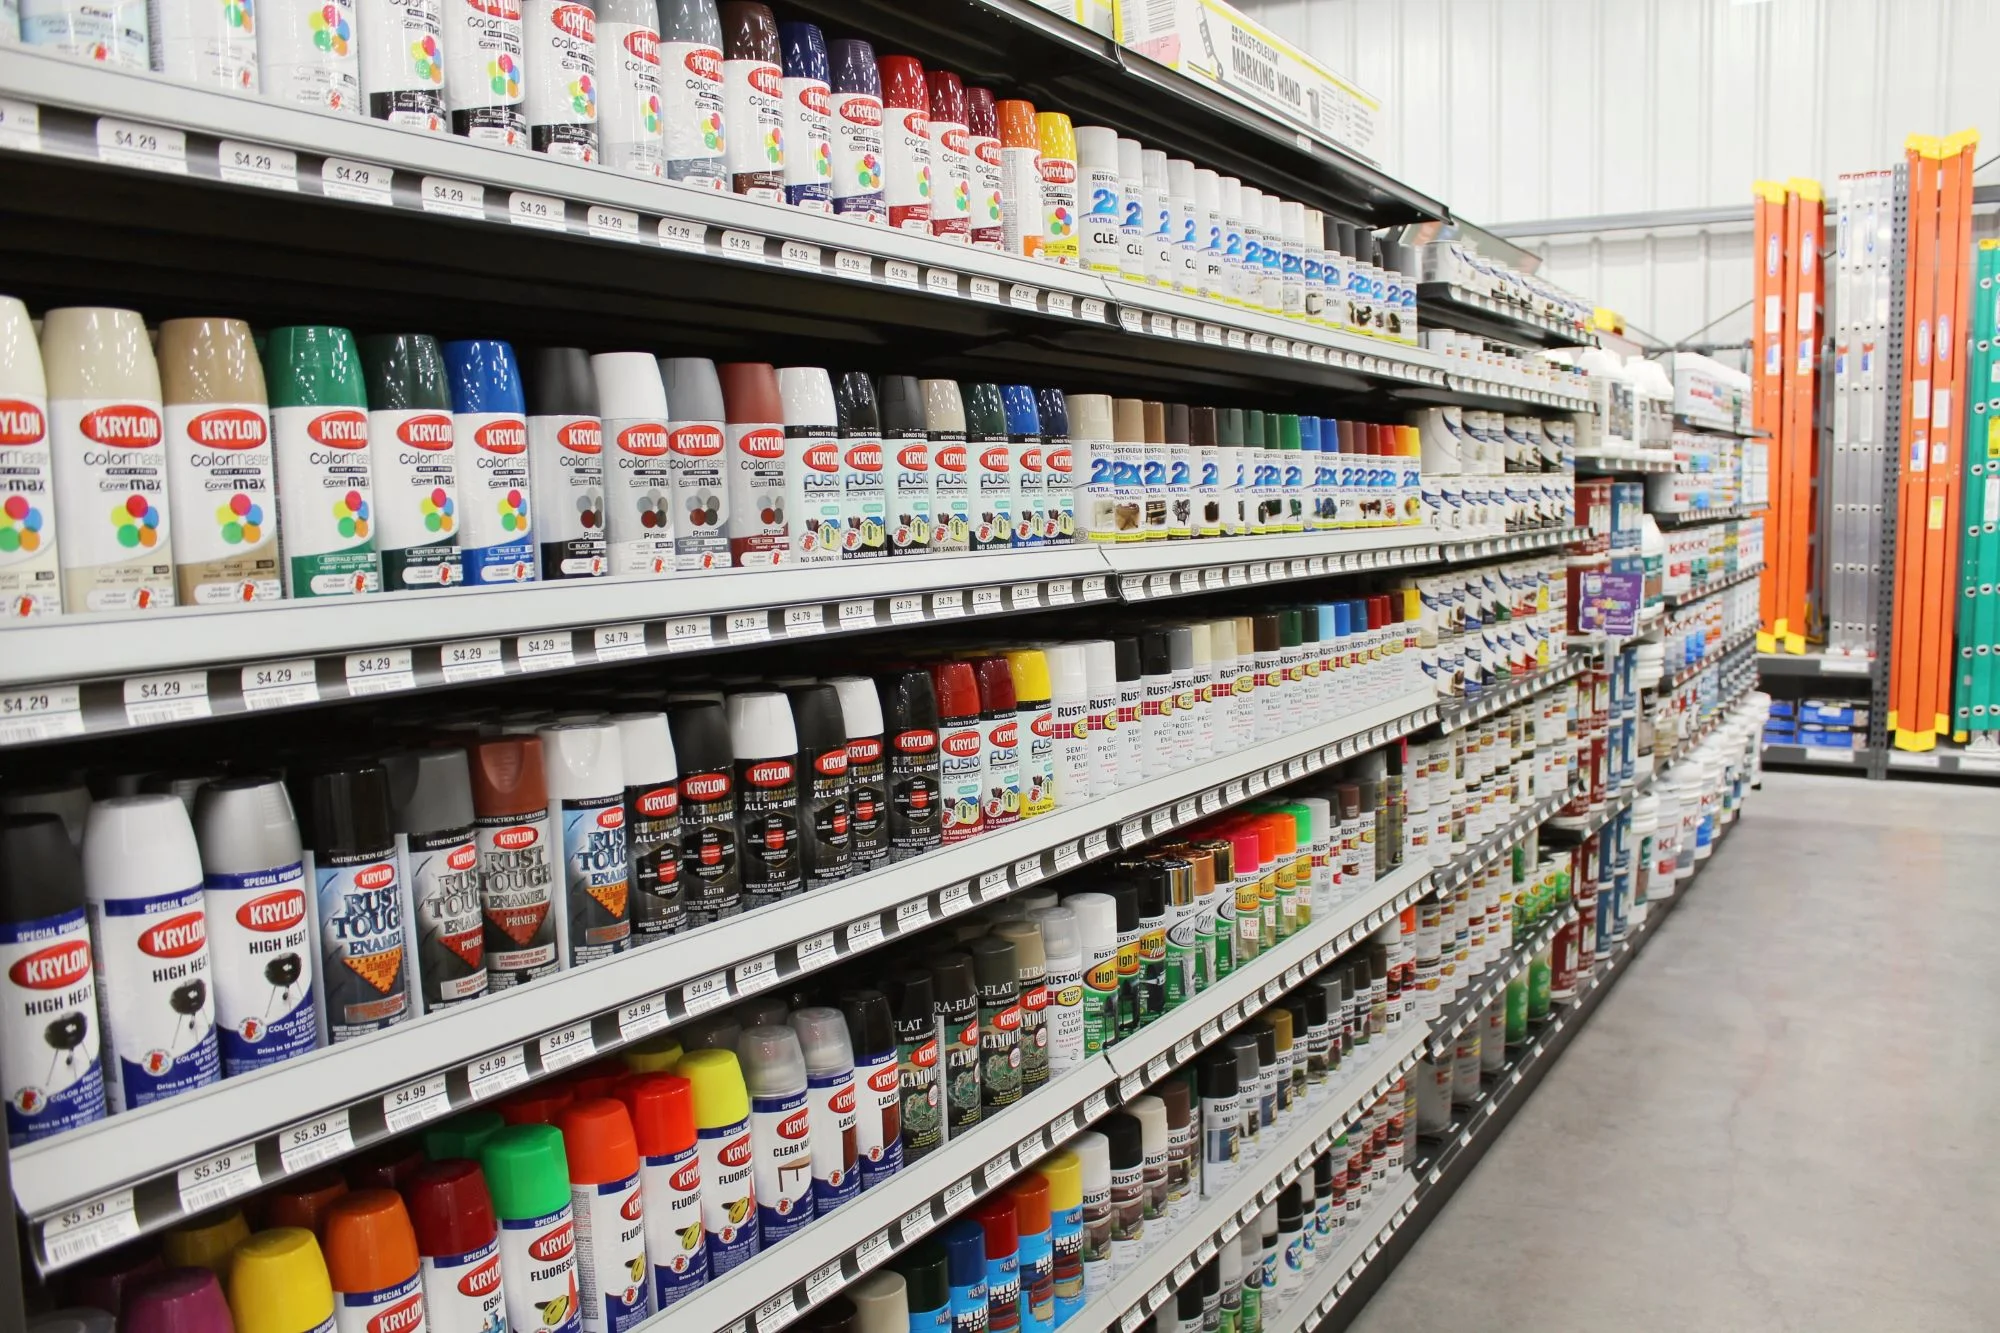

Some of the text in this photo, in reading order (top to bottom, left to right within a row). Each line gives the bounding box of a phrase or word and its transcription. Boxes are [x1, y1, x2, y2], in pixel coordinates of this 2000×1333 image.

[1239, 29, 1278, 65] RUST-OLEUM
[1232, 45, 1275, 92] MARKING
[1277, 71, 1300, 106] WAND
[114, 129, 157, 151] $4.29
[234, 151, 271, 171] $4.29
[335, 165, 370, 184] $4.29
[1042, 167, 1074, 179] KRYLON
[433, 186, 464, 202] $4.29
[519, 201, 548, 217] $4.29
[597, 214, 622, 229] $4.29
[667, 225, 690, 239] $4.29
[729, 236, 751, 250] $4.29
[789, 246, 809, 261] $4.29
[841, 255, 861, 270] $4.29
[1283, 254, 1303, 274] 2X
[891, 265, 909, 279] $4.29
[932, 273, 949, 287] $4.29
[95, 415, 157, 440] KRYLON
[201, 418, 262, 441] KRYLON
[321, 419, 367, 441] KRYLON
[409, 422, 452, 442] KRYLON
[486, 429, 526, 446] KRYLON
[628, 432, 667, 448] KRYLON
[677, 433, 720, 449] KRYLON
[749, 436, 784, 451] KRYLON
[1114, 461, 1144, 485] 2X
[100, 478, 162, 492] Cover max
[205, 477, 266, 491] Cover max
[679, 478, 722, 487] Cover max
[846, 490, 860, 498] FOR
[942, 544, 962, 552] SANDING
[985, 542, 1004, 550] SANDING
[808, 554, 834, 562] SANDING
[854, 550, 878, 559] SANDING
[938, 595, 953, 607] $4.79
[978, 591, 992, 602] $4.79
[845, 604, 863, 617] $4.79
[896, 599, 912, 611] $4.79
[791, 609, 811, 622] $4.79
[674, 623, 697, 636] $4.79
[734, 617, 756, 629] $4.79
[604, 631, 629, 644] $4.79
[528, 639, 555, 652] $4.29
[452, 648, 482, 661] $4.29
[358, 657, 391, 673] $4.29
[256, 669, 292, 686] $4.29
[140, 682, 181, 699] $4.29
[3, 695, 49, 713] $4.29
[900, 734, 934, 749] KRYLON
[950, 736, 980, 751] KRYLON
[848, 742, 879, 758] KRYLON
[752, 766, 791, 782] KRYLON
[892, 762, 939, 774] ALL-IN-ONE
[685, 778, 726, 795] KRYLON
[578, 797, 615, 806] SATISFACTION
[643, 792, 677, 812] KRYLON
[744, 798, 797, 811] ALL-IN-ONE
[515, 810, 546, 822] GUARANTEED
[680, 812, 734, 826] ALL-IN-ONE
[910, 826, 931, 835] GLOSS
[949, 828, 971, 836] SANDING
[425, 833, 461, 848] SATISFACTION
[500, 830, 535, 847] KRYLON
[857, 839, 877, 848] GLOSS
[331, 853, 375, 865] SATISFACTION
[483, 848, 544, 873] RUST
[243, 875, 277, 888] SPECIAL
[361, 868, 391, 885] KRYLON
[478, 863, 551, 894] TOUGH
[769, 871, 786, 879] FLAT
[703, 886, 725, 896] SATIN
[945, 887, 960, 900] $4.99
[489, 890, 546, 909] ENAMEL
[144, 900, 179, 914] SPECIAL
[249, 896, 303, 925] KRYLON
[661, 905, 680, 915] SATIN
[902, 903, 918, 915] $4.99
[506, 915, 537, 927] PRIMER
[853, 921, 871, 934] $4.99
[16, 928, 56, 942] SPECIAL
[152, 920, 205, 953] KRYLON
[249, 929, 307, 955] HIGH HEAT
[804, 938, 823, 953] $4.99
[1140, 936, 1156, 952] High
[25, 946, 88, 984] KRYLON
[742, 961, 763, 975] $4.99
[152, 964, 187, 983] HIGH
[1095, 970, 1114, 985] High
[691, 980, 713, 996] $4.99
[1062, 988, 1080, 998] STOPS
[24, 984, 92, 1017] HIGH HEAT
[1064, 994, 1079, 1002] RUST
[628, 1003, 651, 1020] $4.99
[268, 1022, 293, 1034] COLOR
[1062, 1016, 1082, 1026] CLEAR
[549, 1031, 576, 1048] $4.99
[257, 1047, 273, 1055] Dries
[175, 1053, 199, 1065] COLOR
[479, 1056, 507, 1075] $4.99
[872, 1056, 890, 1065] SPECIAL
[157, 1081, 178, 1091] Dries
[832, 1075, 850, 1086] SPECIAL
[50, 1089, 79, 1104] COLOR
[396, 1084, 426, 1104] $4.99
[782, 1100, 800, 1110] SPECIAL
[28, 1121, 49, 1131] Dries
[293, 1122, 328, 1144] $5.39
[723, 1126, 744, 1138] SPECIAL
[674, 1149, 694, 1162] SPECIAL
[773, 1144, 800, 1158] CLEAR
[193, 1158, 231, 1181] $5.39
[948, 1182, 964, 1197] $6.99
[62, 1202, 105, 1228] $5.39
[535, 1213, 559, 1227] SPECIAL
[906, 1209, 922, 1224] $4.79
[906, 1210, 922, 1224] $4.79
[463, 1248, 486, 1263] SPECIAL
[372, 1289, 402, 1304] SPECIAL
[378, 1299, 422, 1329] KRYLON
